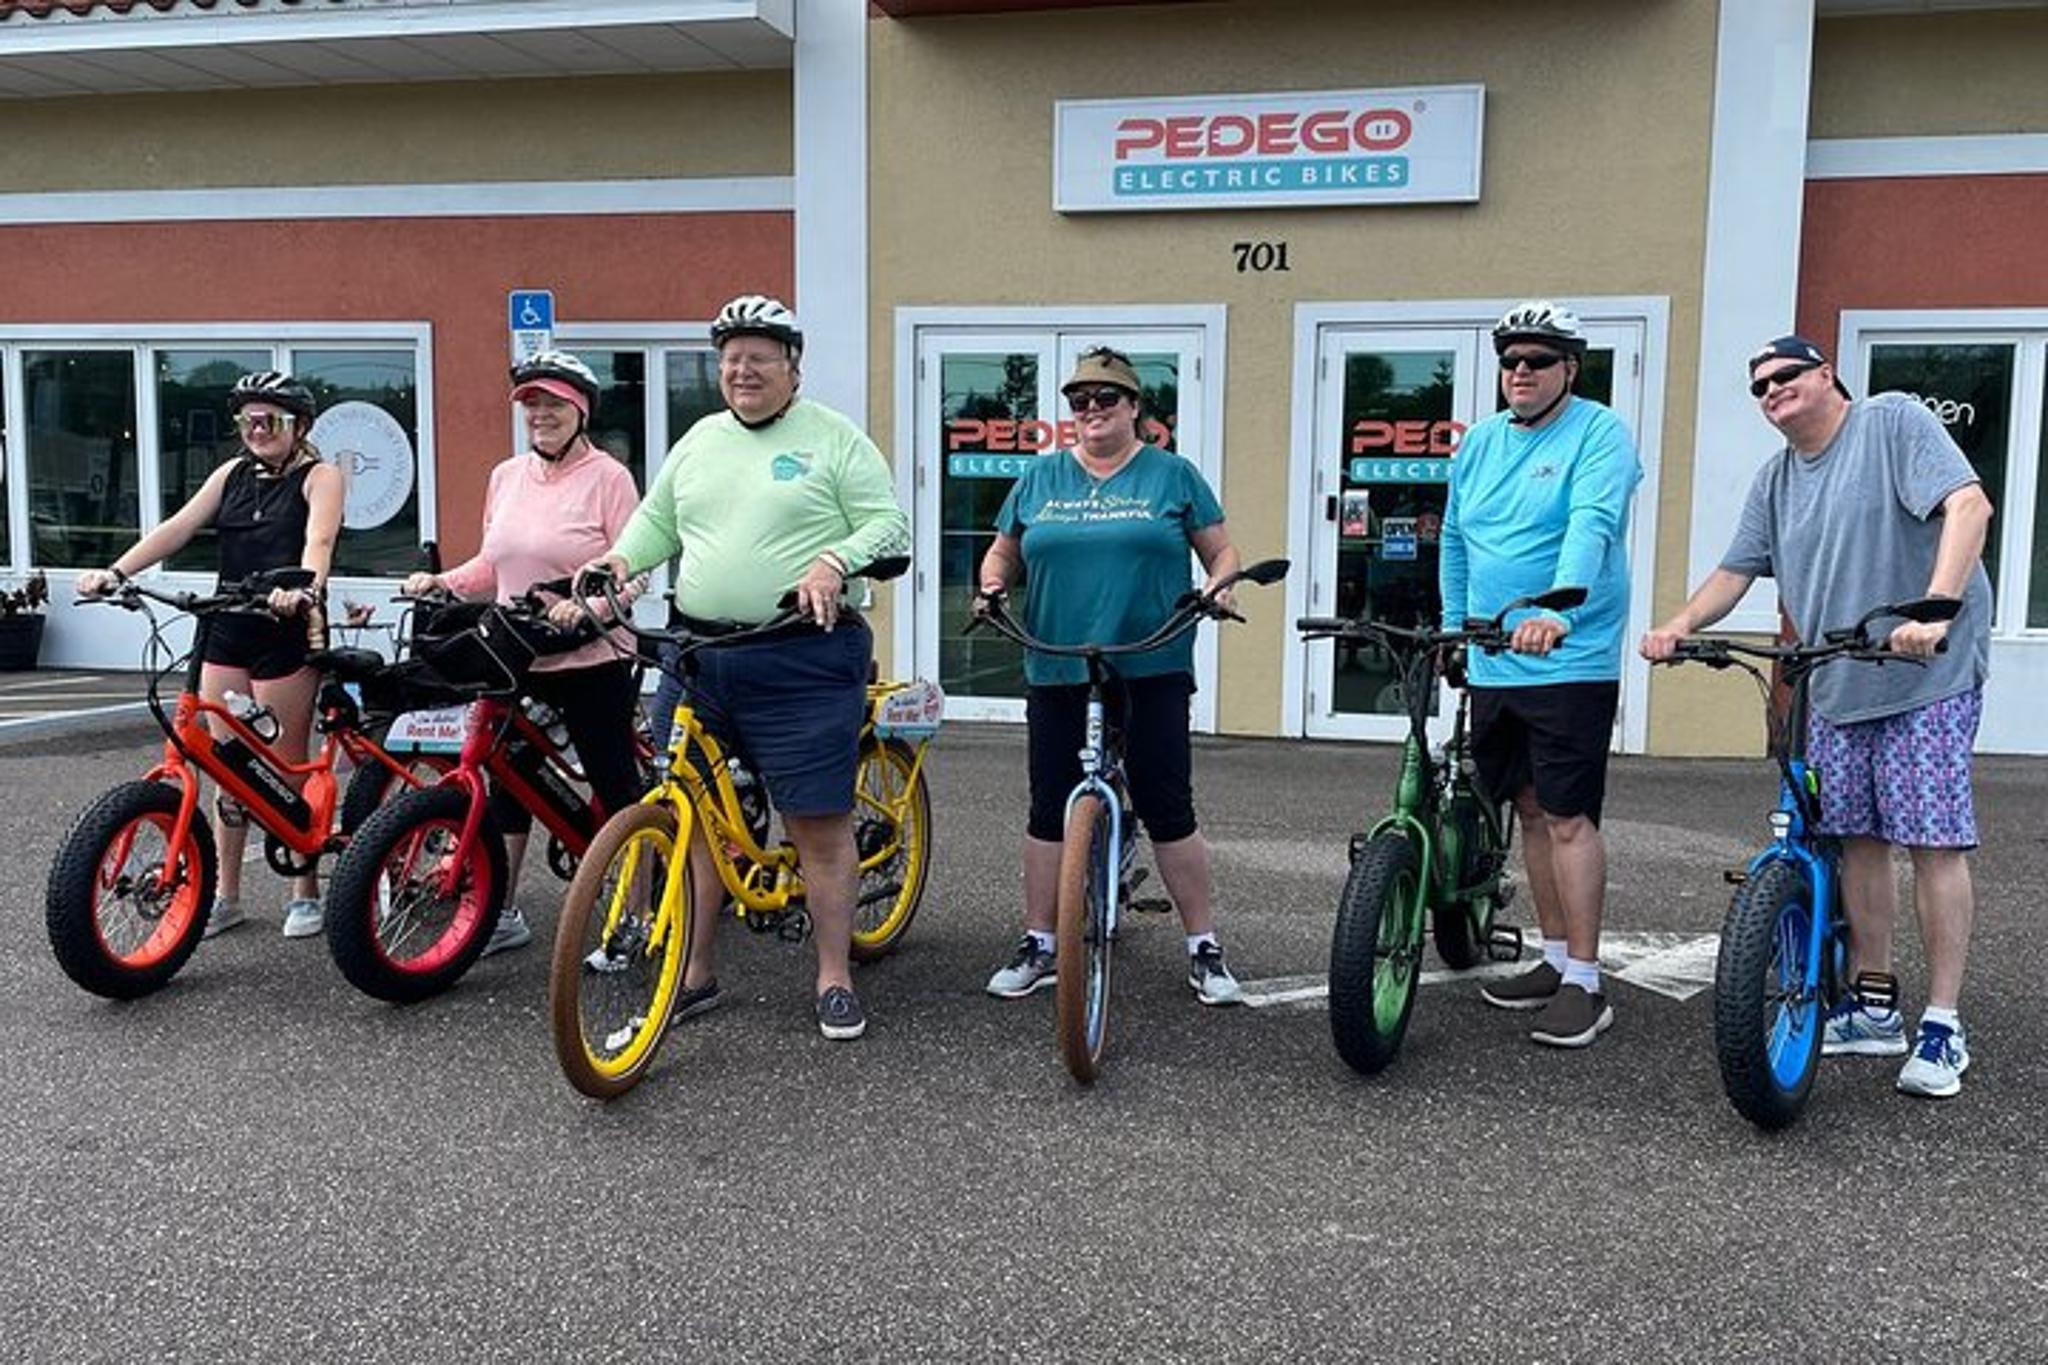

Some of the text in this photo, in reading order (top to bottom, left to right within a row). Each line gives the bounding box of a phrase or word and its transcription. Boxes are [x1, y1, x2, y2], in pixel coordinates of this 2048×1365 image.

[1115, 109, 1412, 160] PEDEGO
[1120, 163, 1402, 190] ELECTRIC BIKES
[1233, 242, 1291, 272] 701
[1353, 420, 1468, 453] PED
[954, 459, 1029, 474] ELECT
[1356, 463, 1455, 477] ELECT
